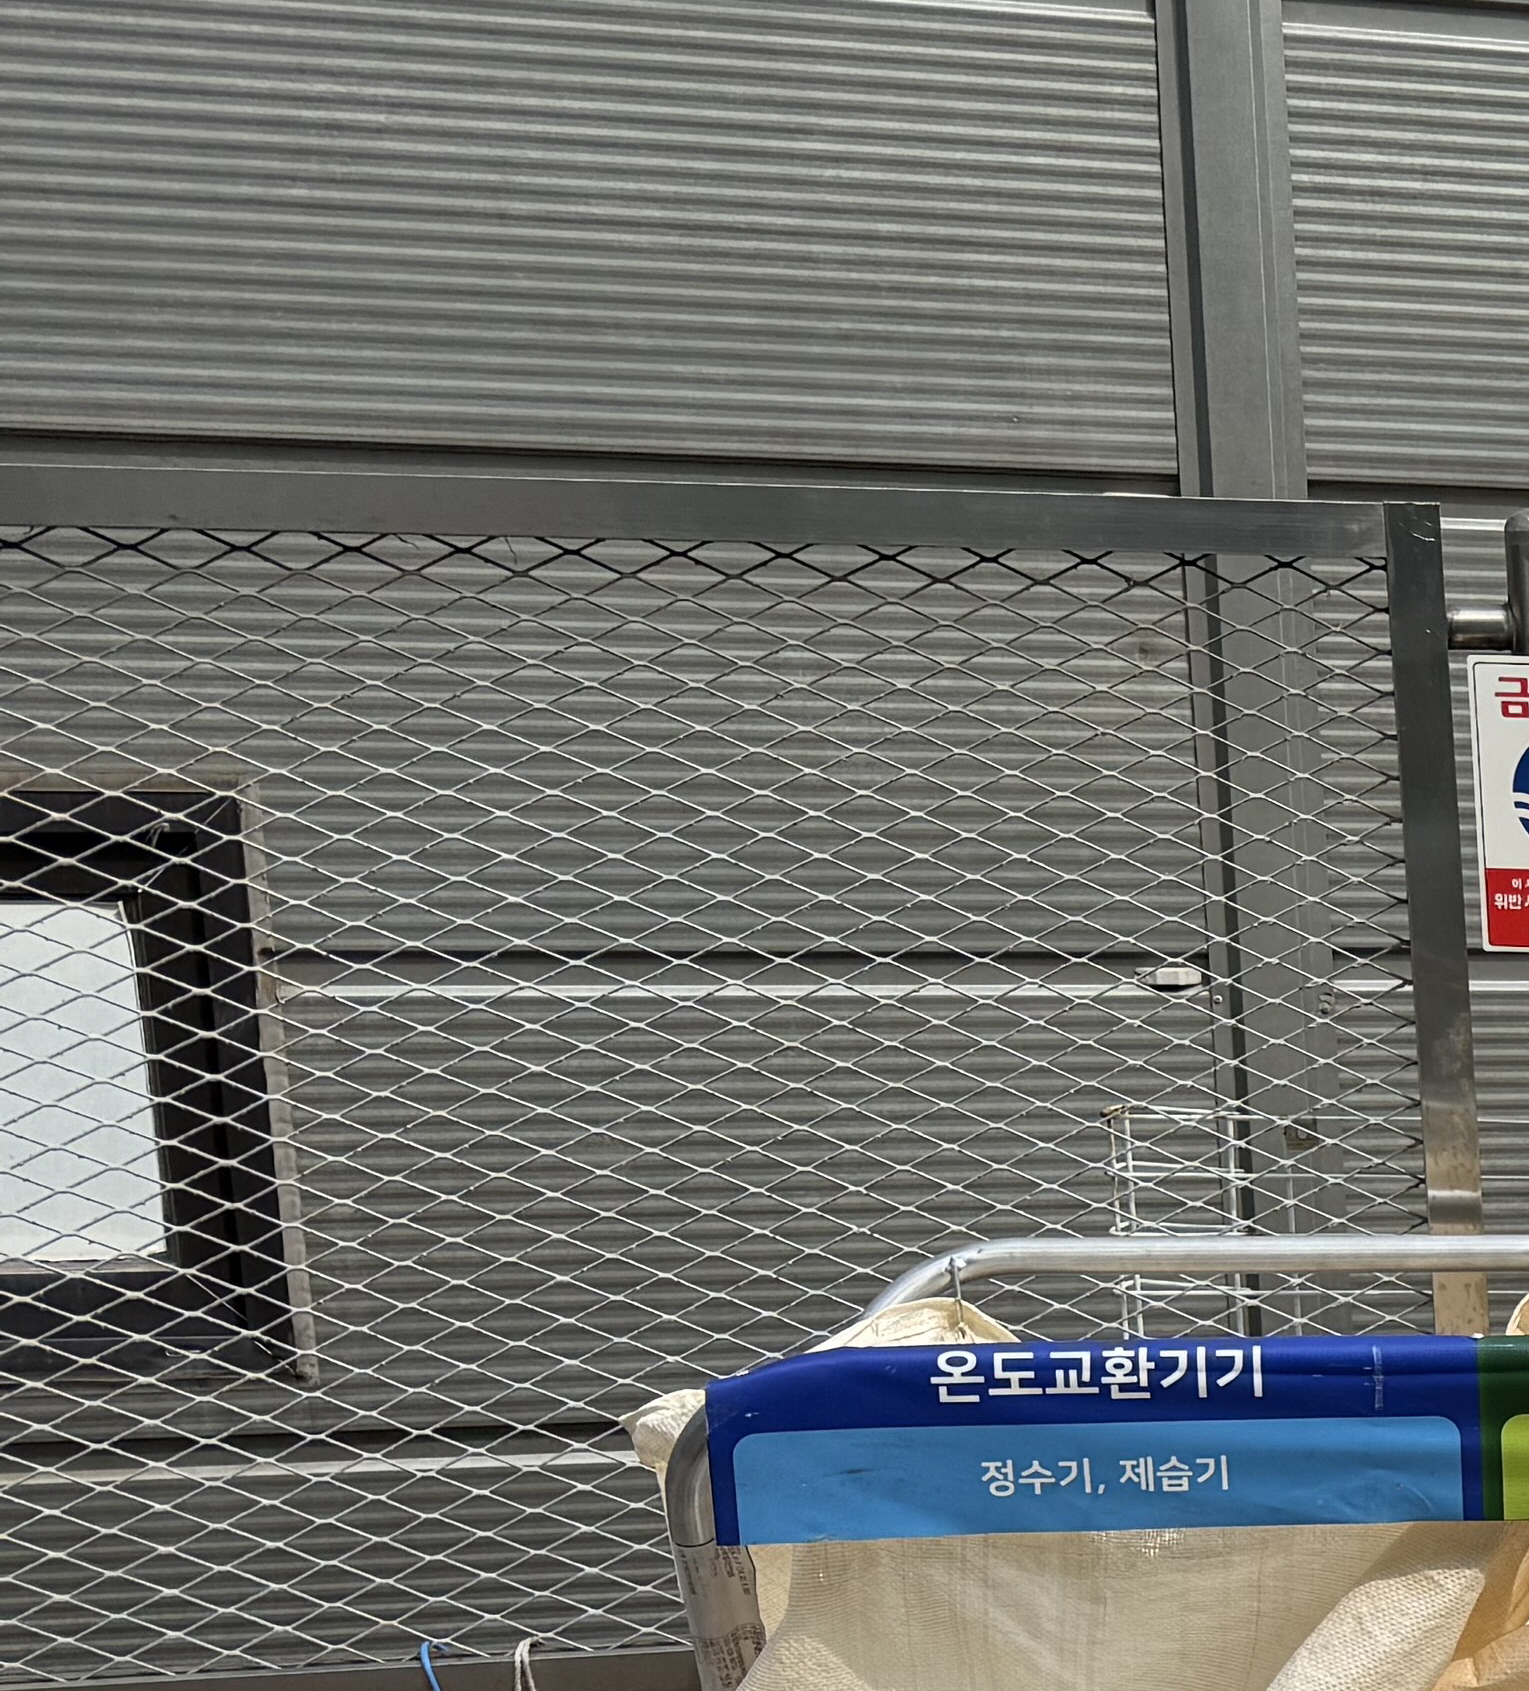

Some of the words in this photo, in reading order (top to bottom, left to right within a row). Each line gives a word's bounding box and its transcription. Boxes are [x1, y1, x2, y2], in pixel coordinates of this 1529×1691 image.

[1494, 894, 1521, 910] 위반
[930, 1345, 1264, 1403] 온도교환기기
[980, 1457, 1105, 1497] 정수기,
[1119, 1455, 1230, 1493] 제습기
